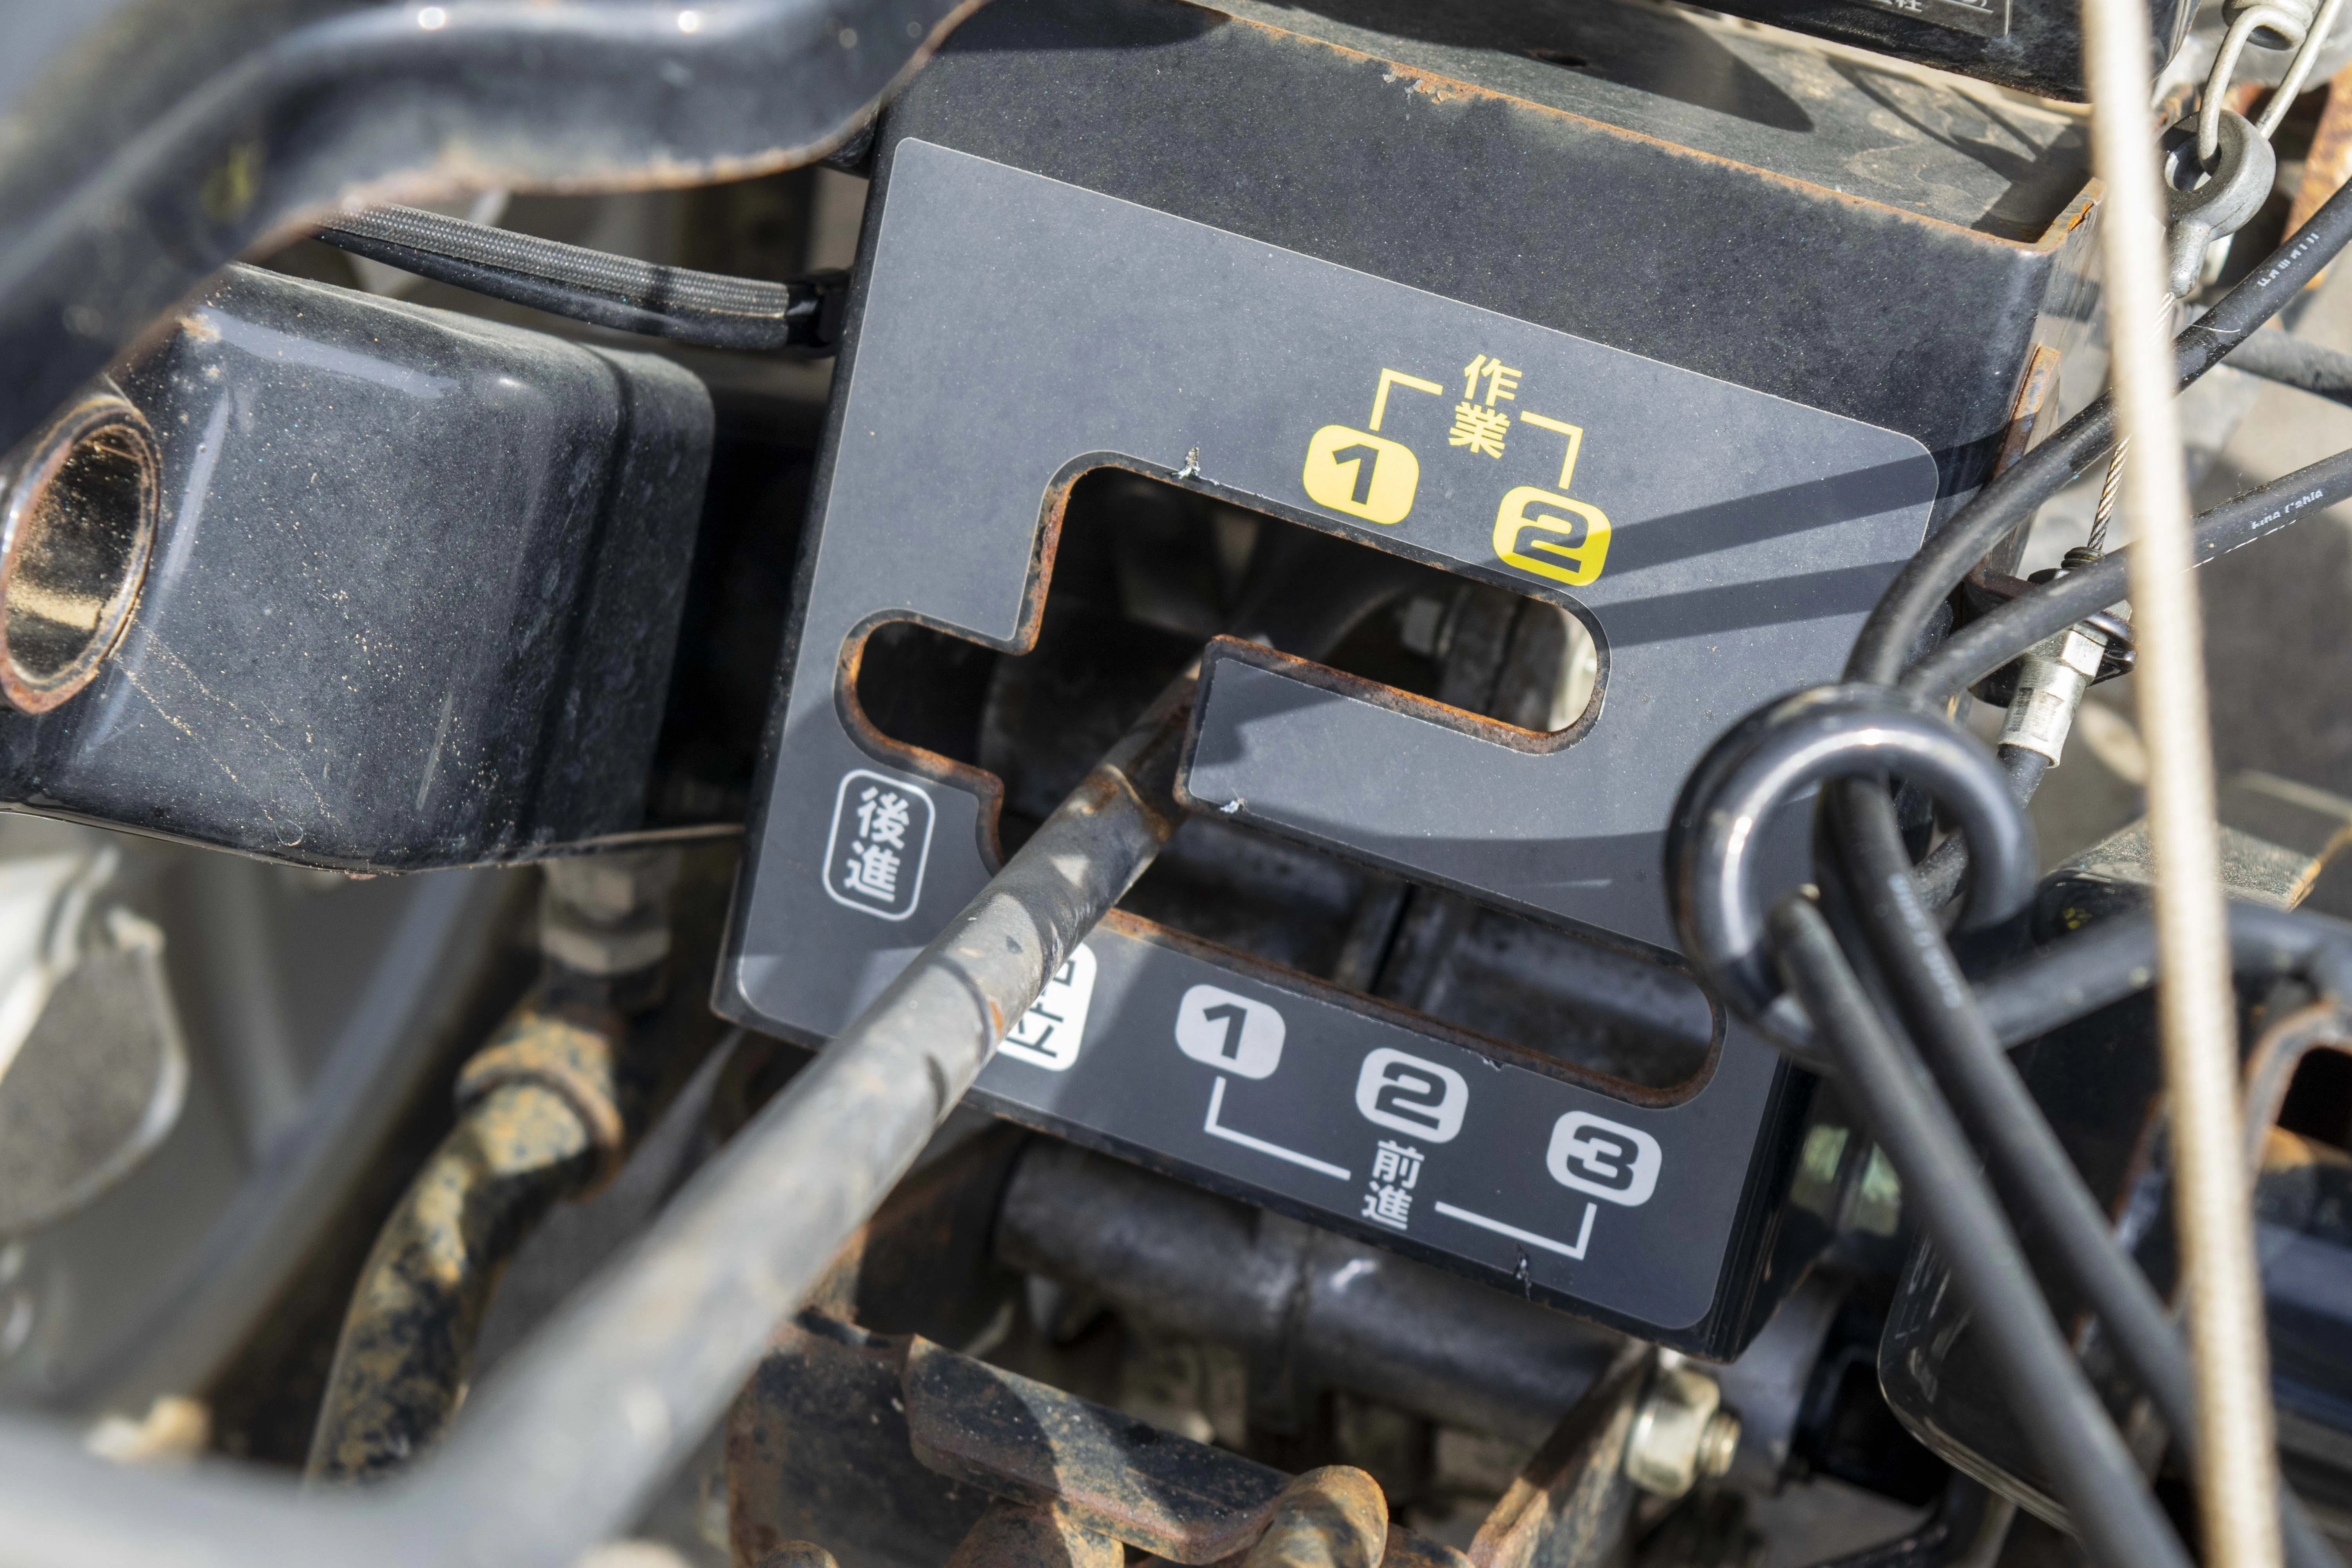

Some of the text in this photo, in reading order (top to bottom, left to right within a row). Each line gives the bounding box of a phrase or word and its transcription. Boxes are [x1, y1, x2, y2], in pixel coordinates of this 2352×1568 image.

[1448, 354, 1523, 459] 作業
[1332, 443, 1379, 505] 1
[1512, 501, 1588, 573] 2
[844, 786, 910, 902] 後進
[1203, 1004, 1247, 1060] 1
[1375, 1061, 1446, 1130] 2
[1362, 1140, 1425, 1230] 前進
[1566, 1124, 1639, 1191] 3
